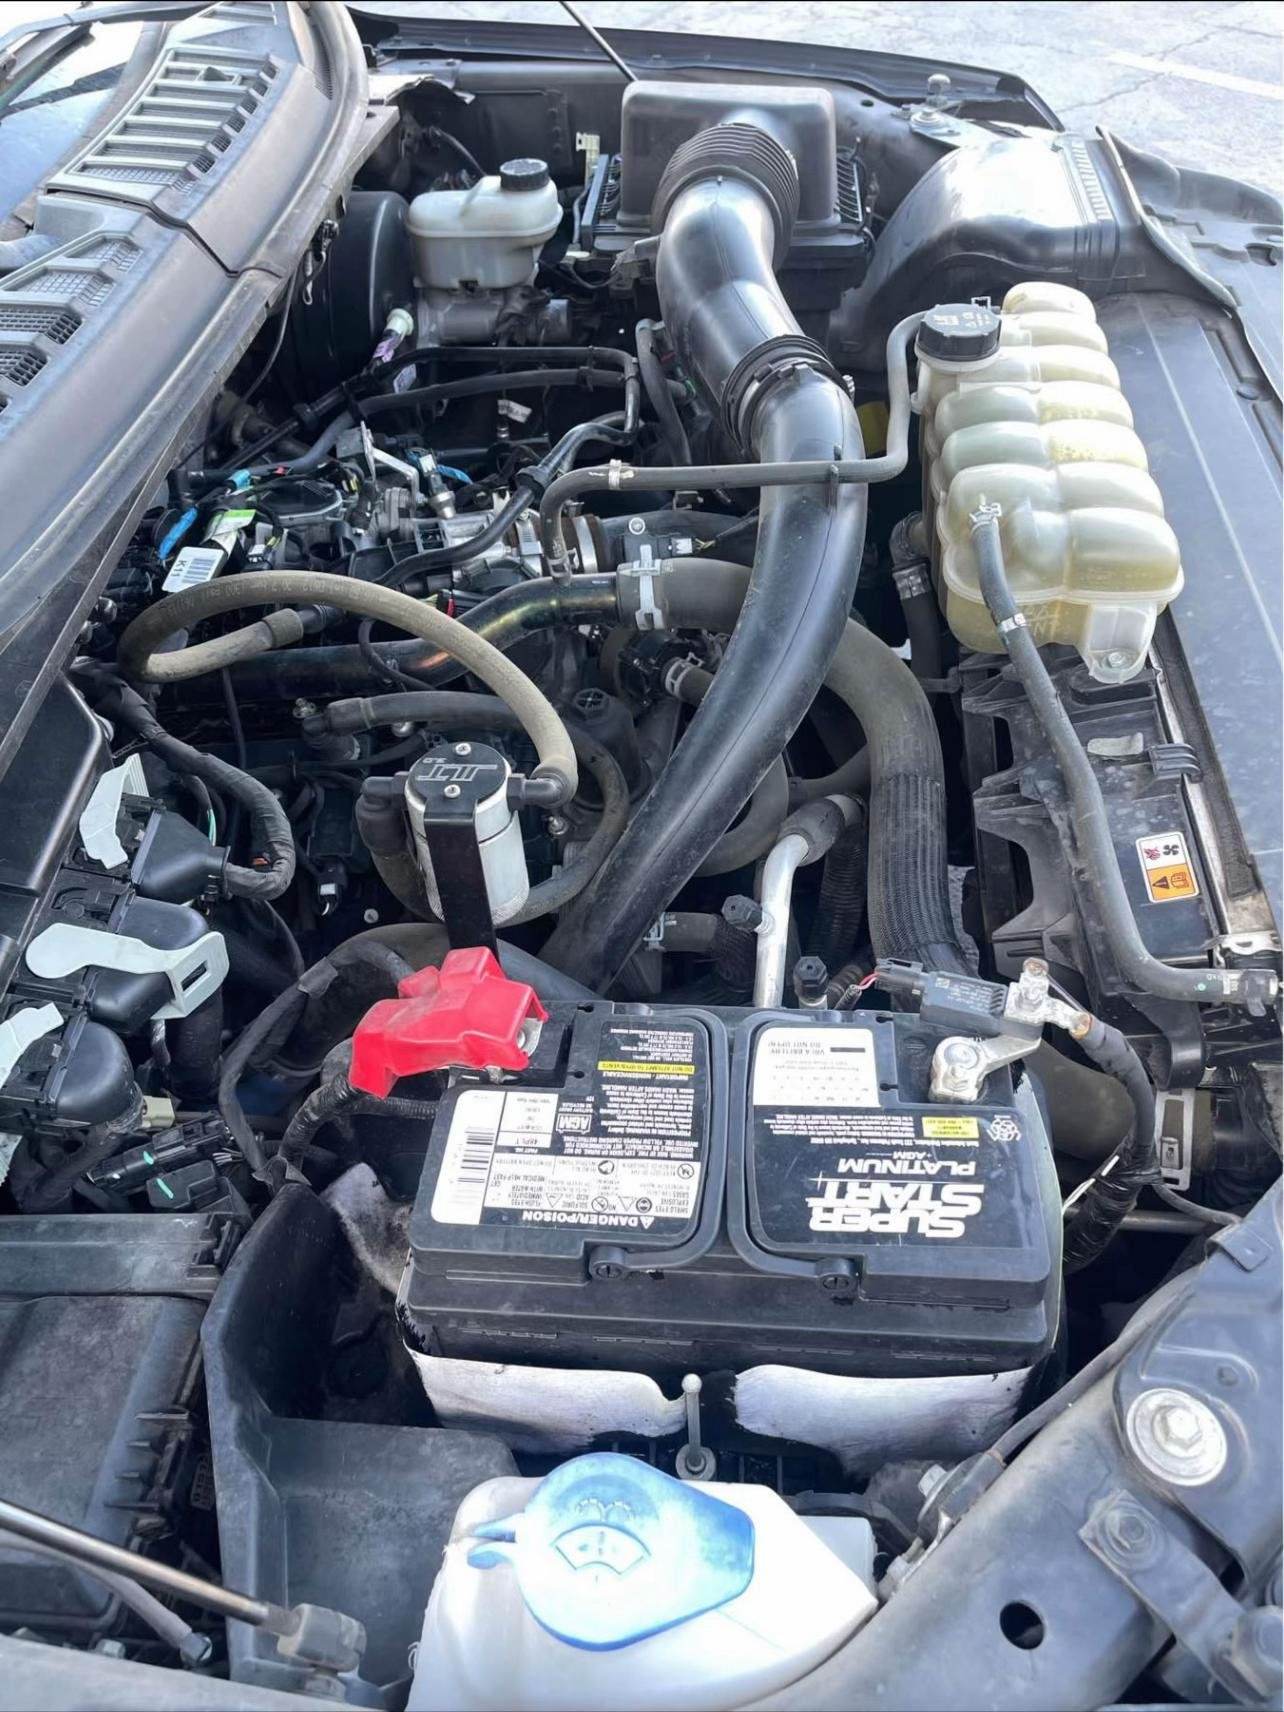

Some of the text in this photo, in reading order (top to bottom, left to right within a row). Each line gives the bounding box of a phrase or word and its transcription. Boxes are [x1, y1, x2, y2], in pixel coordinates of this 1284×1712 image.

[560, 1115, 590, 1130] AGM
[837, 1158, 976, 1175] PLATINUM
[660, 1198, 689, 1206] EXPLOSIVE
[805, 1181, 984, 1216] START
[522, 1210, 638, 1227] DANGER/POISON
[809, 1207, 965, 1238] SUPER
